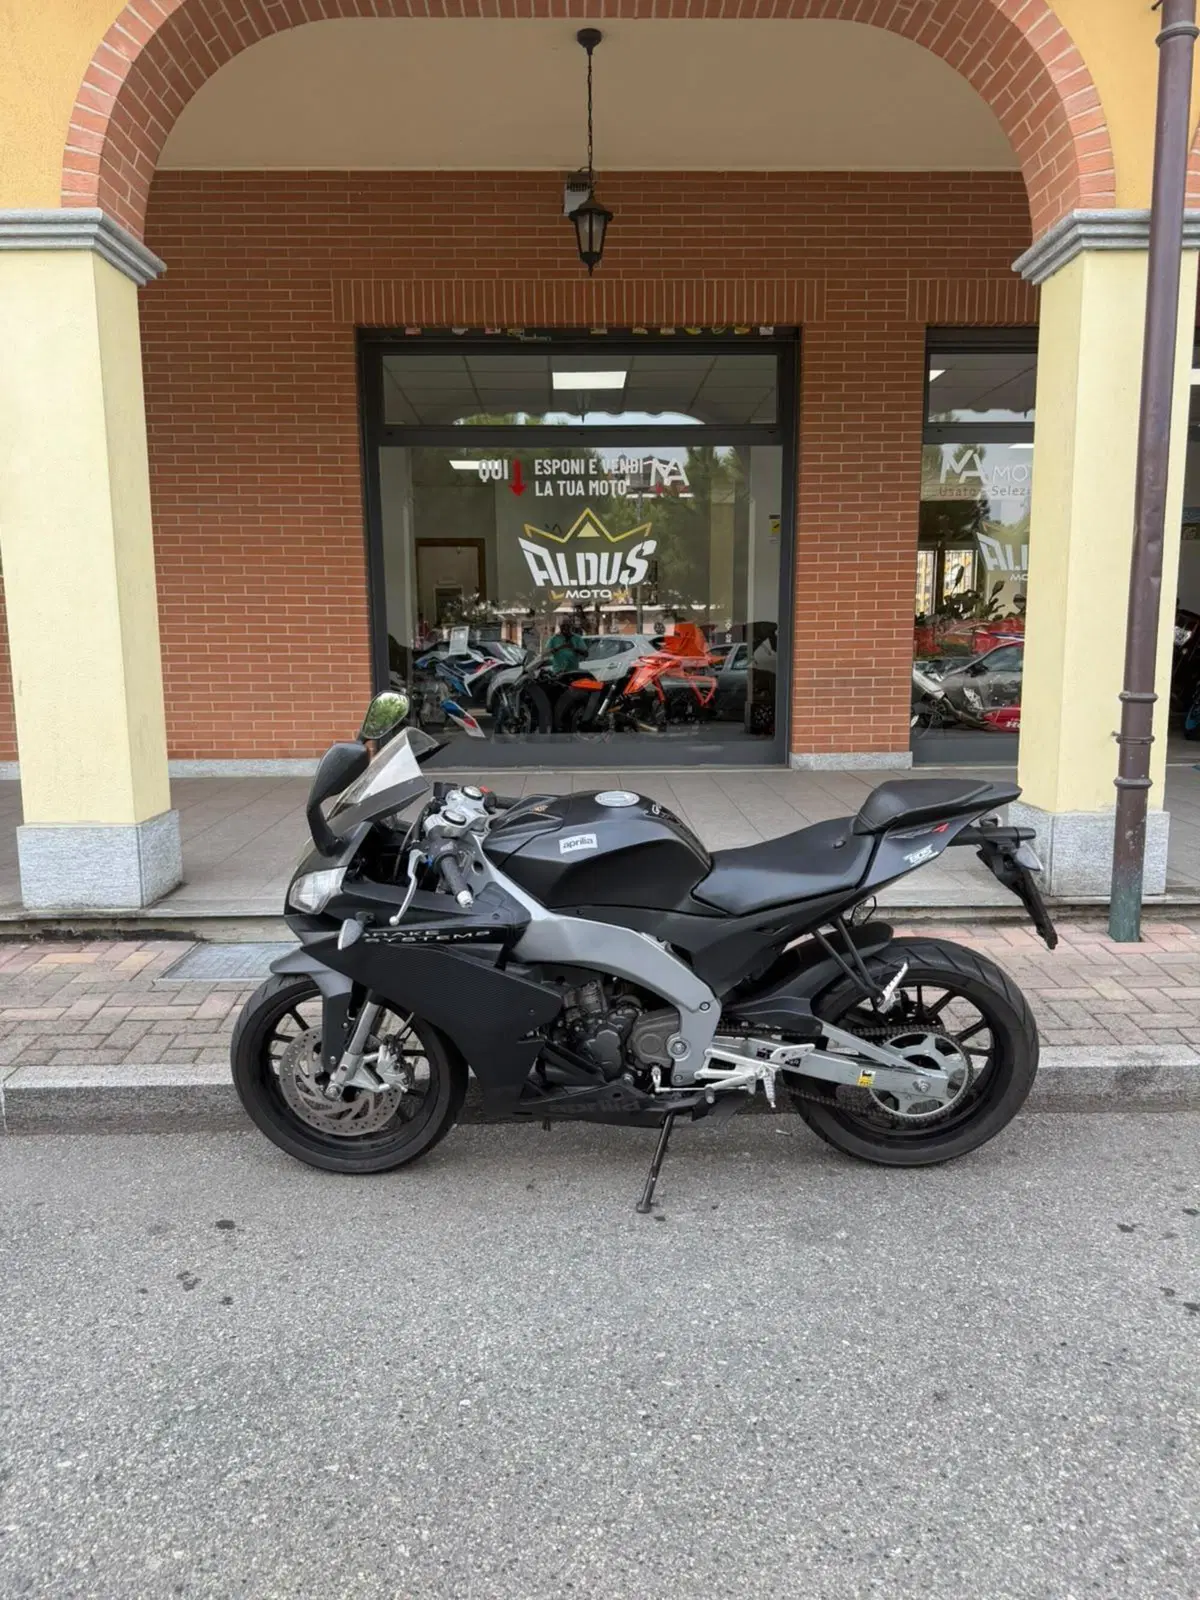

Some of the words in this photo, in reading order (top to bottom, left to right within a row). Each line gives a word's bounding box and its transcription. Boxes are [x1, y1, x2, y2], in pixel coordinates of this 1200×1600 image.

[478, 459, 509, 483] QUI
[534, 458, 585, 475] ESPONI
[589, 458, 598, 474] E
[601, 458, 644, 474] VENDI
[993, 464, 1031, 482] MO
[535, 480, 554, 496] LA
[557, 480, 585, 496] TUA
[589, 480, 627, 496] MOTO
[939, 486, 977, 497] Usato
[518, 536, 658, 587] ALDUS
[565, 589, 613, 599] MOTO
[563, 836, 594, 849] aprilia
